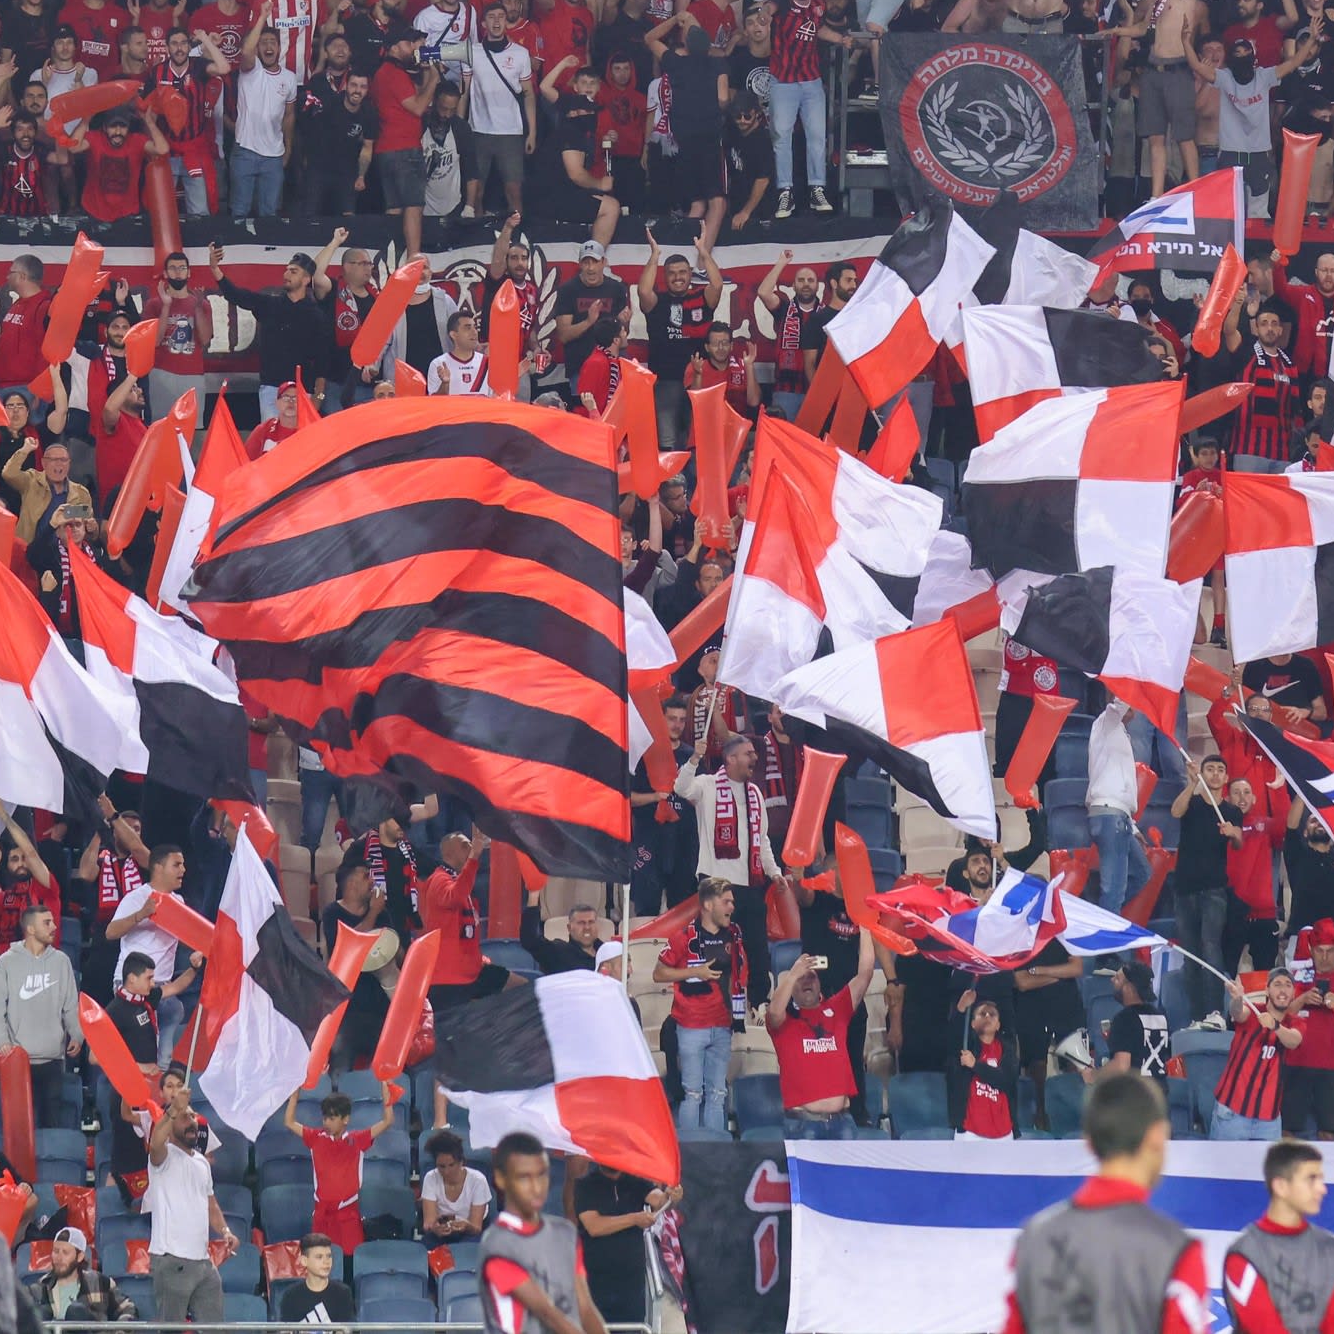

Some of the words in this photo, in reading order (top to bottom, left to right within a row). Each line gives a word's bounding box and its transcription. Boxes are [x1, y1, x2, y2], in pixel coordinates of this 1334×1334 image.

[916, 46, 979, 85] מלחה
[983, 46, 1053, 97] בריגדה
[912, 146, 963, 195] ירושלים
[1016, 144, 1073, 199] אולטראס
[964, 192, 996, 203] ועל
[1146, 240, 1194, 256] תירא
[1198, 241, 1224, 258] אל
[24, 973, 50, 989] NIKE
[1261, 1045, 1277, 1060] 10
